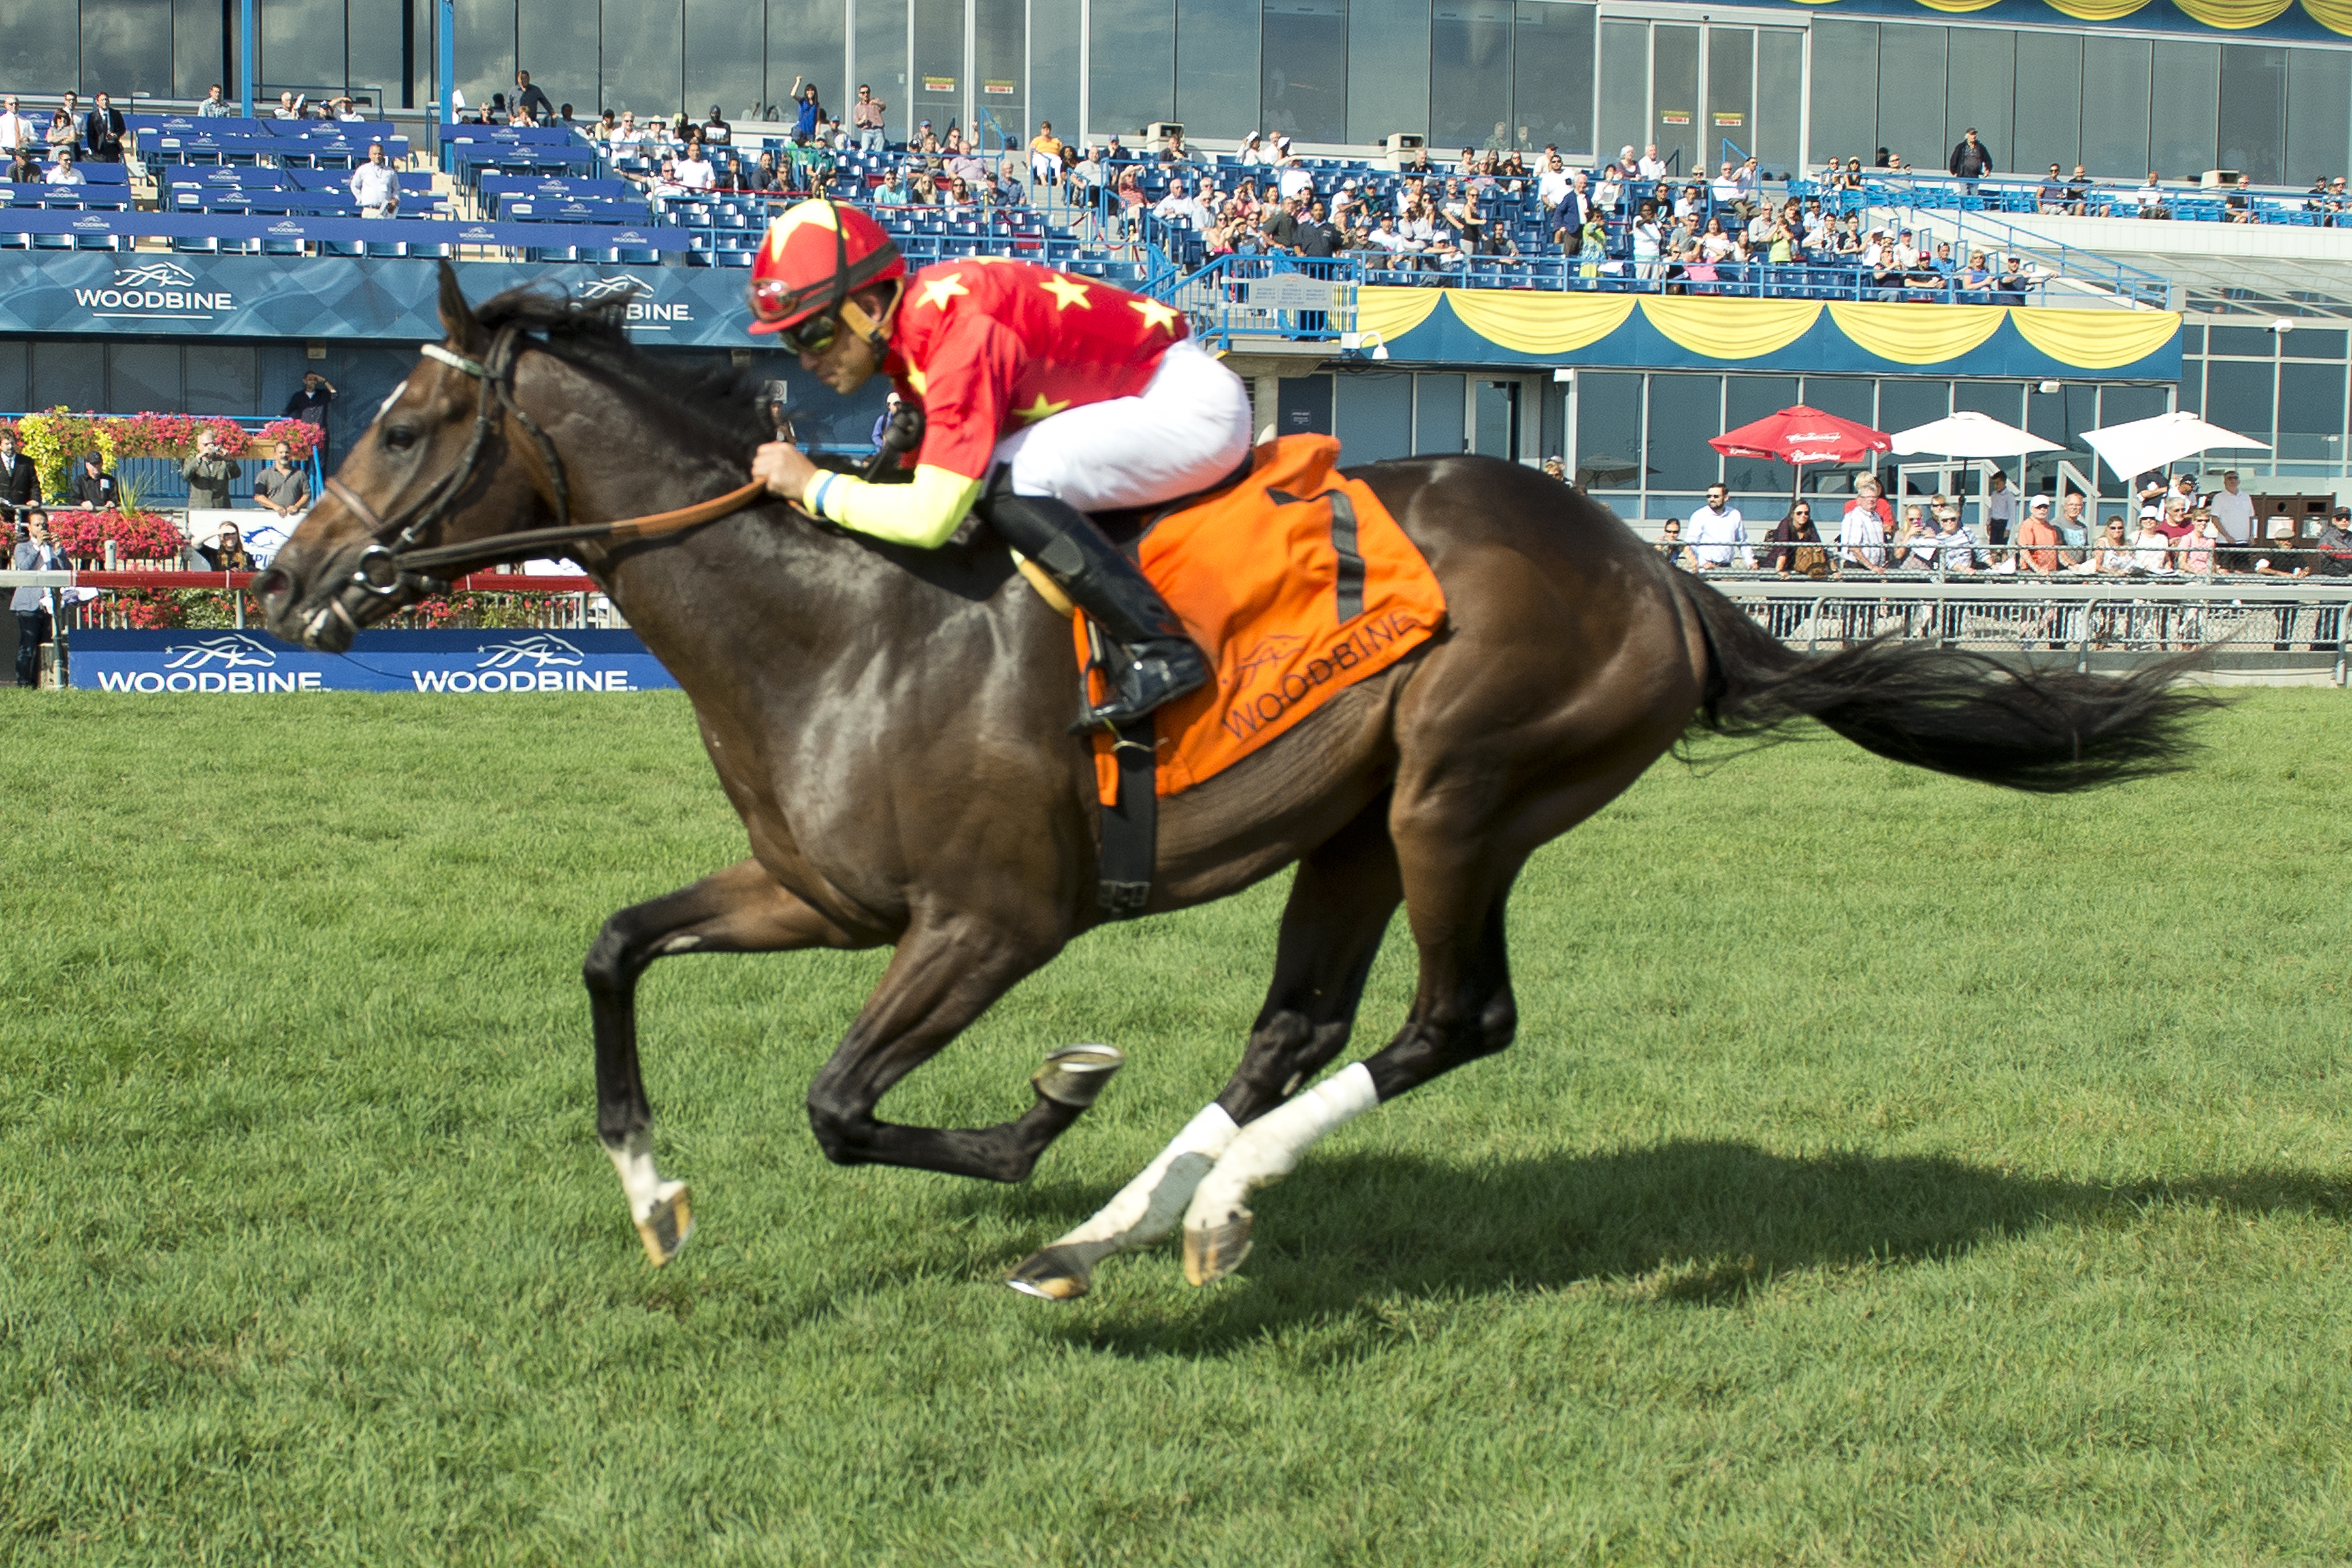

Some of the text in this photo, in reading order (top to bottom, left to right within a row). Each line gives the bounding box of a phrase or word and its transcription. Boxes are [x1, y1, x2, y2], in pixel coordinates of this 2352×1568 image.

[74, 288, 233, 310] WOODBINE
[97, 672, 322, 693] WOODBINE
[412, 670, 629, 693] WOODBINE
[1220, 608, 1418, 740] WOODBINE
